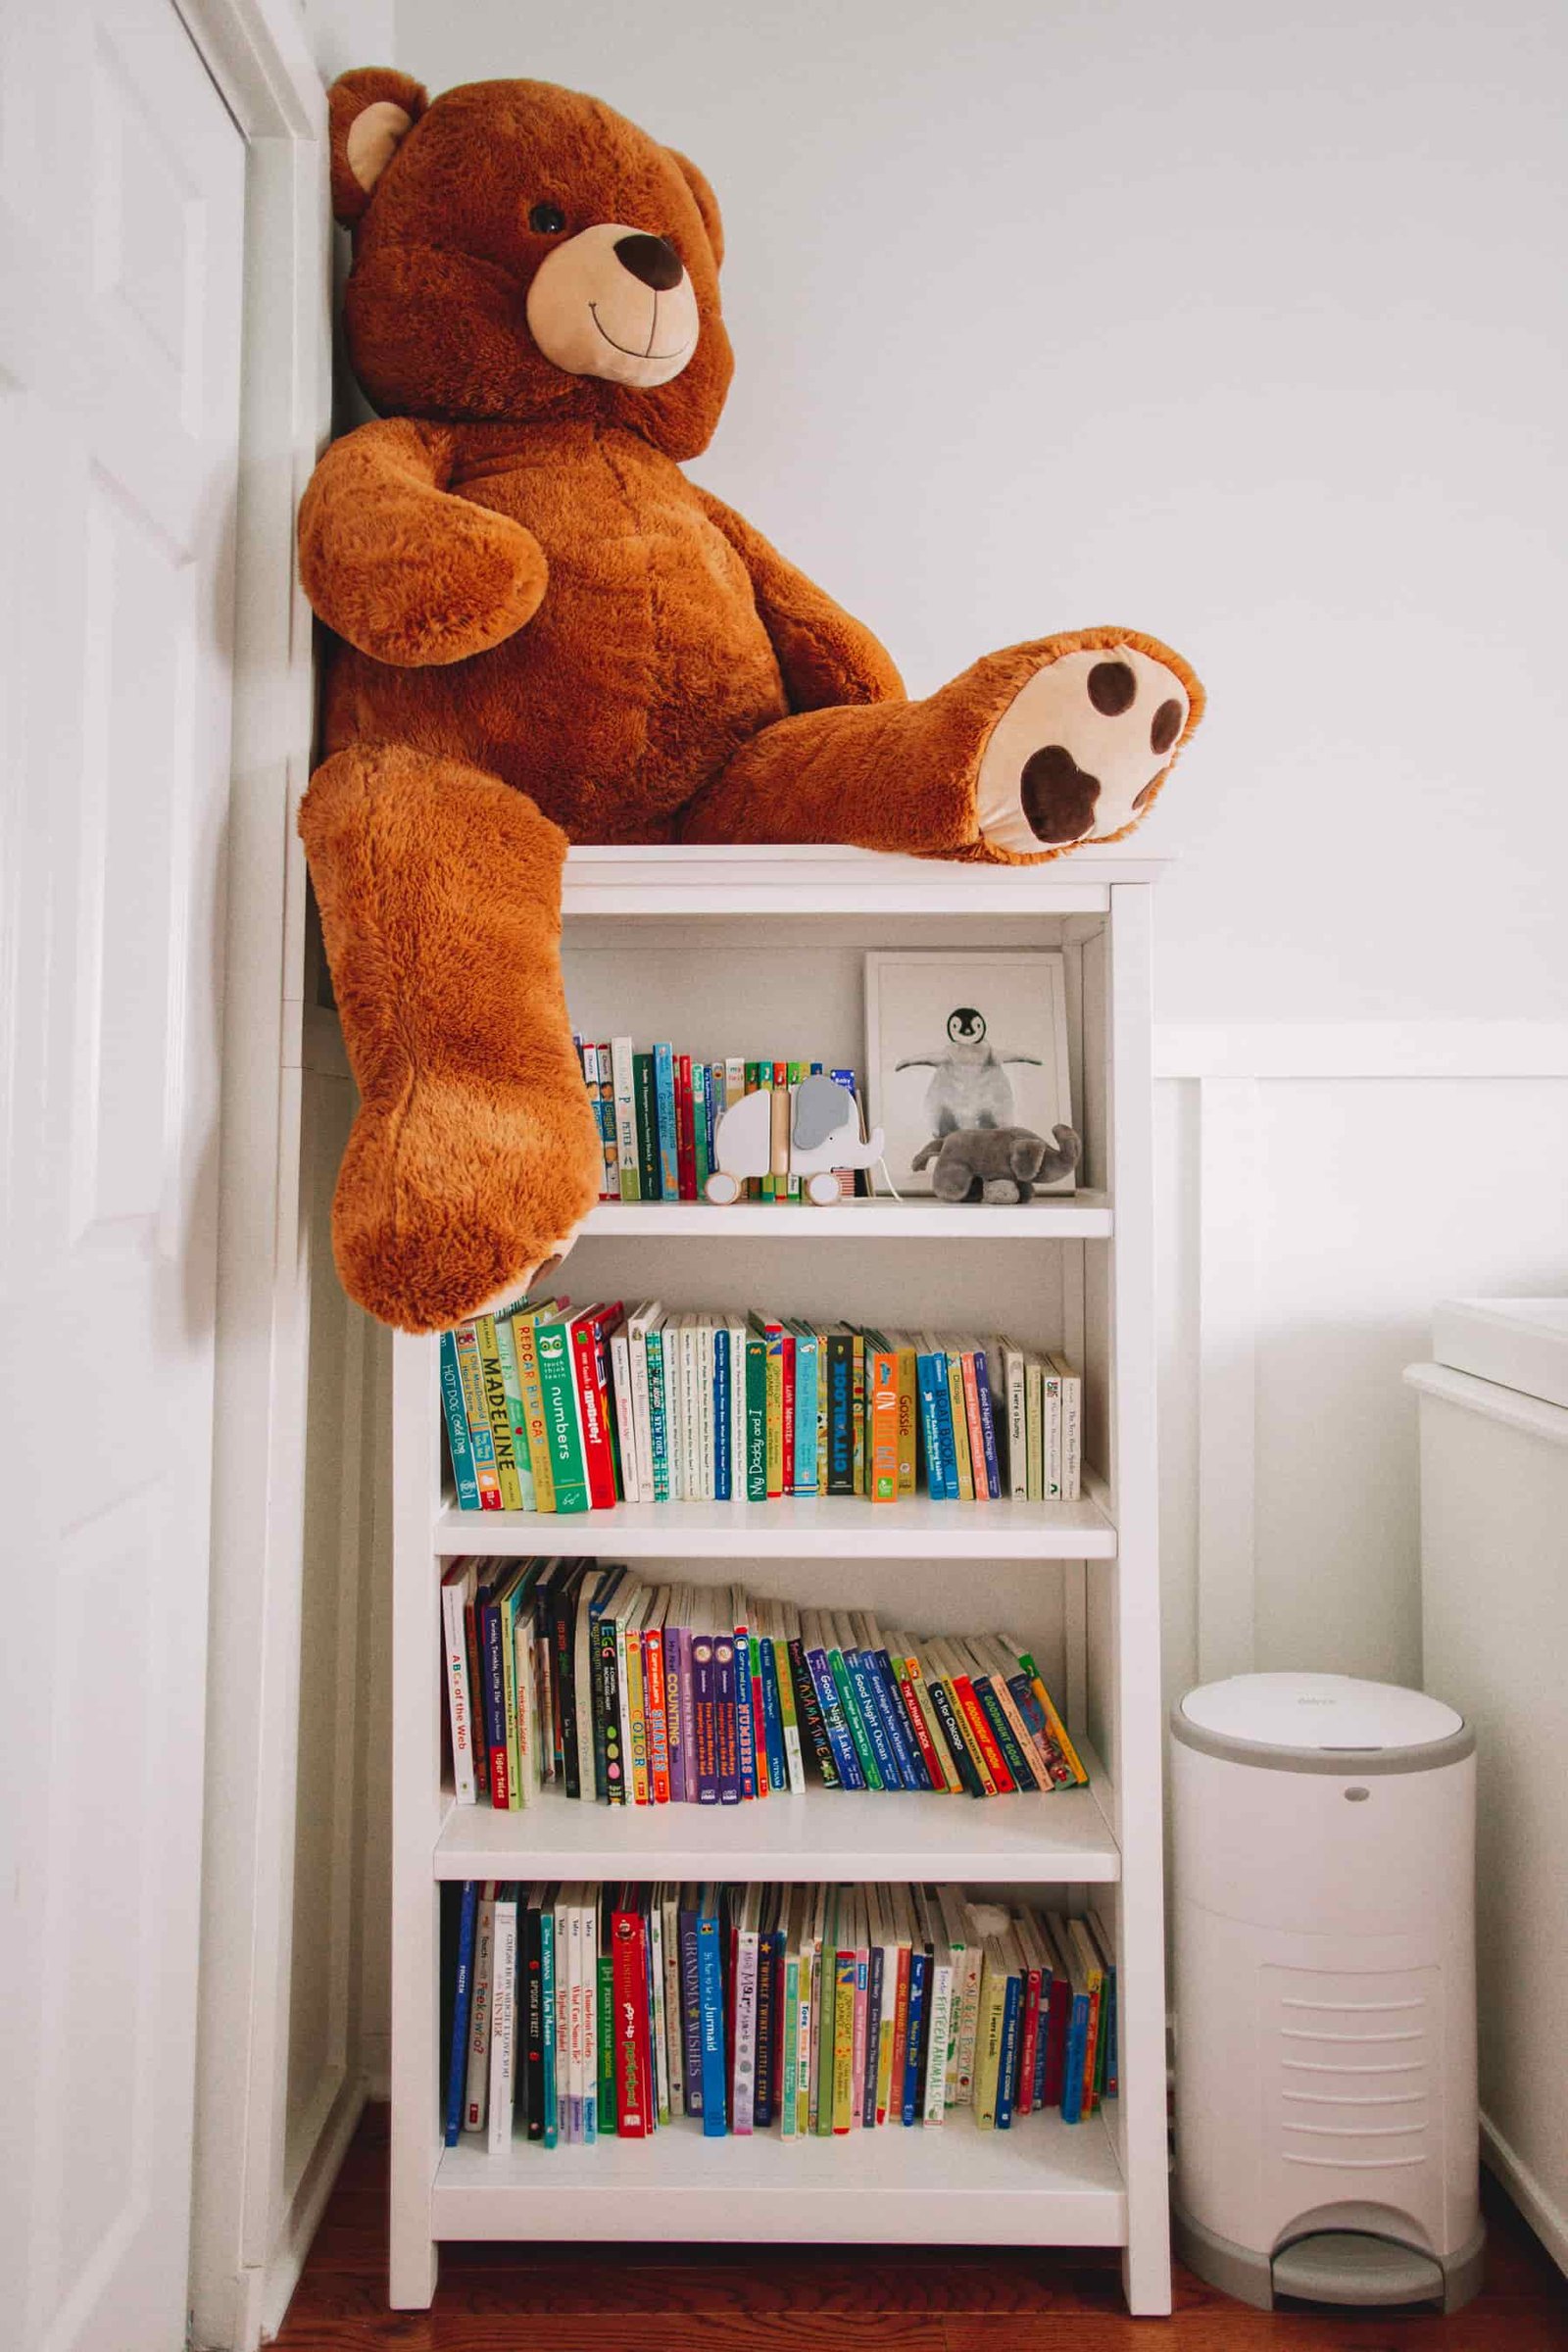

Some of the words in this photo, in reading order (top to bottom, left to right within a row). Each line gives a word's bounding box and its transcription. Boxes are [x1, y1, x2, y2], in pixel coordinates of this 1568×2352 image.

[518, 1326, 531, 1349] RED
[442, 1364, 456, 1387] HOT
[523, 1353, 536, 1379] CAR
[446, 1391, 458, 1411] DOG
[466, 1392, 474, 1412] Farm
[473, 1374, 486, 1419] MacDonald
[877, 1392, 897, 1410] ON
[953, 1374, 961, 1404] Chicago
[966, 1383, 975, 1402] Good
[980, 1388, 989, 1407] Good
[482, 1357, 515, 1472] MADELINE
[899, 1395, 912, 1437] Gossie
[936, 1389, 950, 1423] BOAT
[968, 1403, 978, 1424] Night
[982, 1407, 992, 1429] Night
[451, 1414, 464, 1437] Cold
[551, 1386, 570, 1460] numbers
[654, 1414, 662, 1433] NEW
[752, 1419, 761, 1437] and
[453, 1438, 466, 1455] Dog
[655, 1436, 663, 1457] YORK
[749, 1439, 764, 1474] Daddy
[940, 1428, 954, 1467] BOOK
[984, 1431, 995, 1460] Chicago
[750, 1478, 763, 1495] My
[601, 1626, 615, 1658] EGG
[454, 1689, 466, 1700] of
[492, 1673, 501, 1690] Little
[455, 1703, 466, 1723] the
[666, 1673, 680, 1745] COUNTING
[797, 1674, 816, 1725] PAJAMA
[717, 1702, 726, 1735] Jumping
[820, 1675, 833, 1700] Good
[828, 1703, 843, 1732] Night
[840, 1736, 853, 1760] Lake
[855, 1674, 866, 1697] Good
[863, 1699, 877, 1727] Night
[874, 1730, 888, 1760] Ocean
[872, 1676, 882, 1694] Good
[878, 1694, 889, 1714] Night
[886, 1715, 896, 1732] New
[892, 1733, 906, 1760] Orleans
[907, 1699, 922, 1731] ALPHABET
[918, 1732, 929, 1748] BOOK
[940, 1705, 950, 1717] for
[946, 1718, 963, 1750] Chicago
[984, 1695, 1010, 1741] GOODNIGHT
[1005, 1743, 1021, 1766] GOON
[457, 1725, 467, 1750] Web
[631, 1709, 647, 1776] COLORS
[652, 1708, 665, 1772] SHAPES
[739, 1703, 753, 1774] NUMBERS
[964, 1700, 990, 1743] GOODNIGHT
[984, 1746, 999, 1769] MOON
[494, 1752, 505, 1775] tiger
[495, 1778, 506, 1799] tales
[479, 1936, 489, 1958] Touch
[458, 1965, 466, 1994] FROZEN
[504, 1967, 513, 1990] HOW
[685, 1931, 703, 2006] GRANDMA
[760, 1960, 769, 1999] TWINKLE
[503, 1992, 513, 2024] MUCH
[530, 1980, 539, 2010] SPOOKY
[545, 1997, 553, 2013] Am
[570, 1984, 581, 2006] What
[961, 1983, 977, 2035] SNUGGLE
[494, 1991, 504, 2038] WINTER
[760, 2003, 768, 2041] TWINKLE
[934, 1996, 947, 2045] FIFTEEN
[502, 2031, 511, 2058] LOVE
[689, 2021, 702, 2077] WISHES
[759, 2045, 768, 2075] LITTLE
